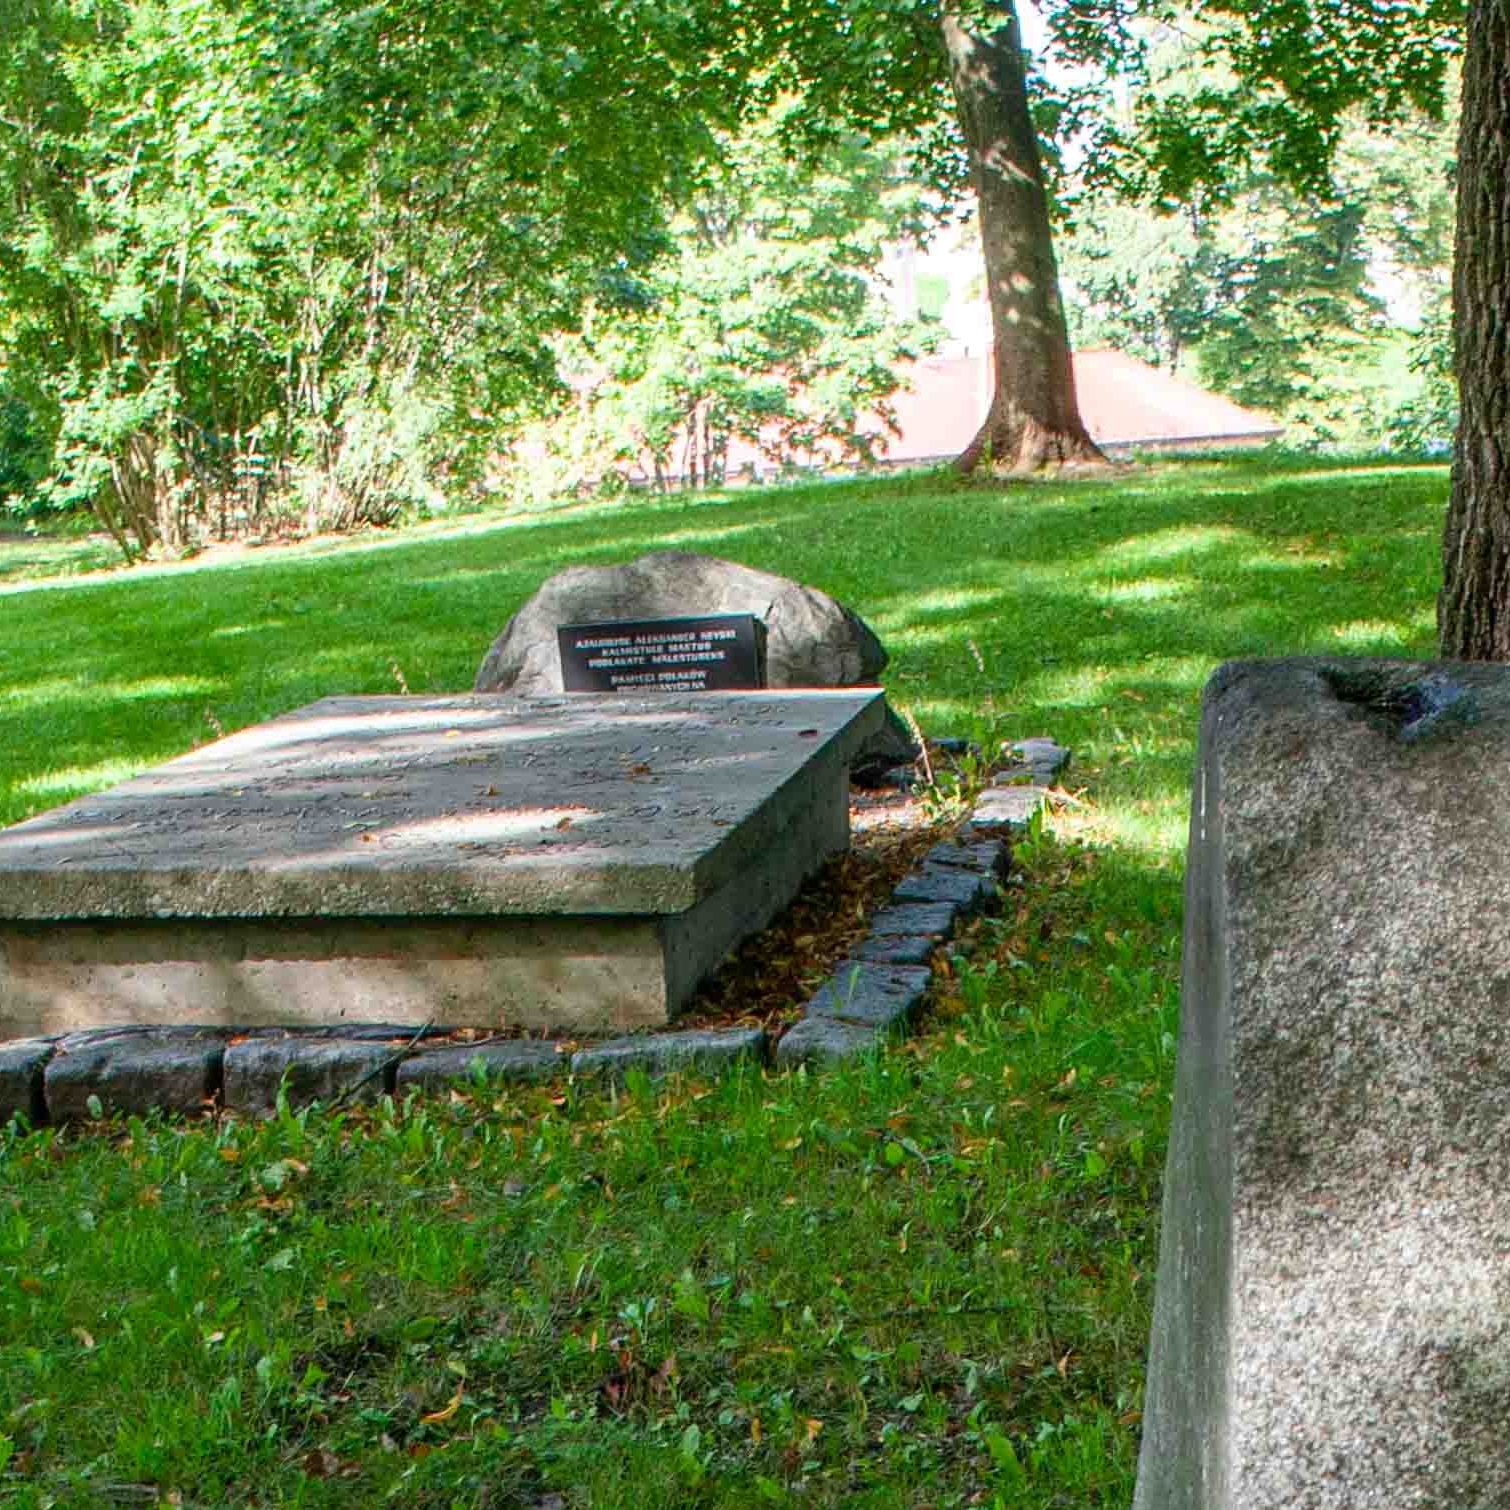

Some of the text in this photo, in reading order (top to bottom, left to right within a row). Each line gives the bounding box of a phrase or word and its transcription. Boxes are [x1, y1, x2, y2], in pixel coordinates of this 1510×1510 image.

[635, 632, 695, 644] ALEKSANDER
[700, 629, 737, 641] NEVSKI
[602, 645, 663, 656] KALMISTULE
[588, 657, 645, 668] POOLAKATE
